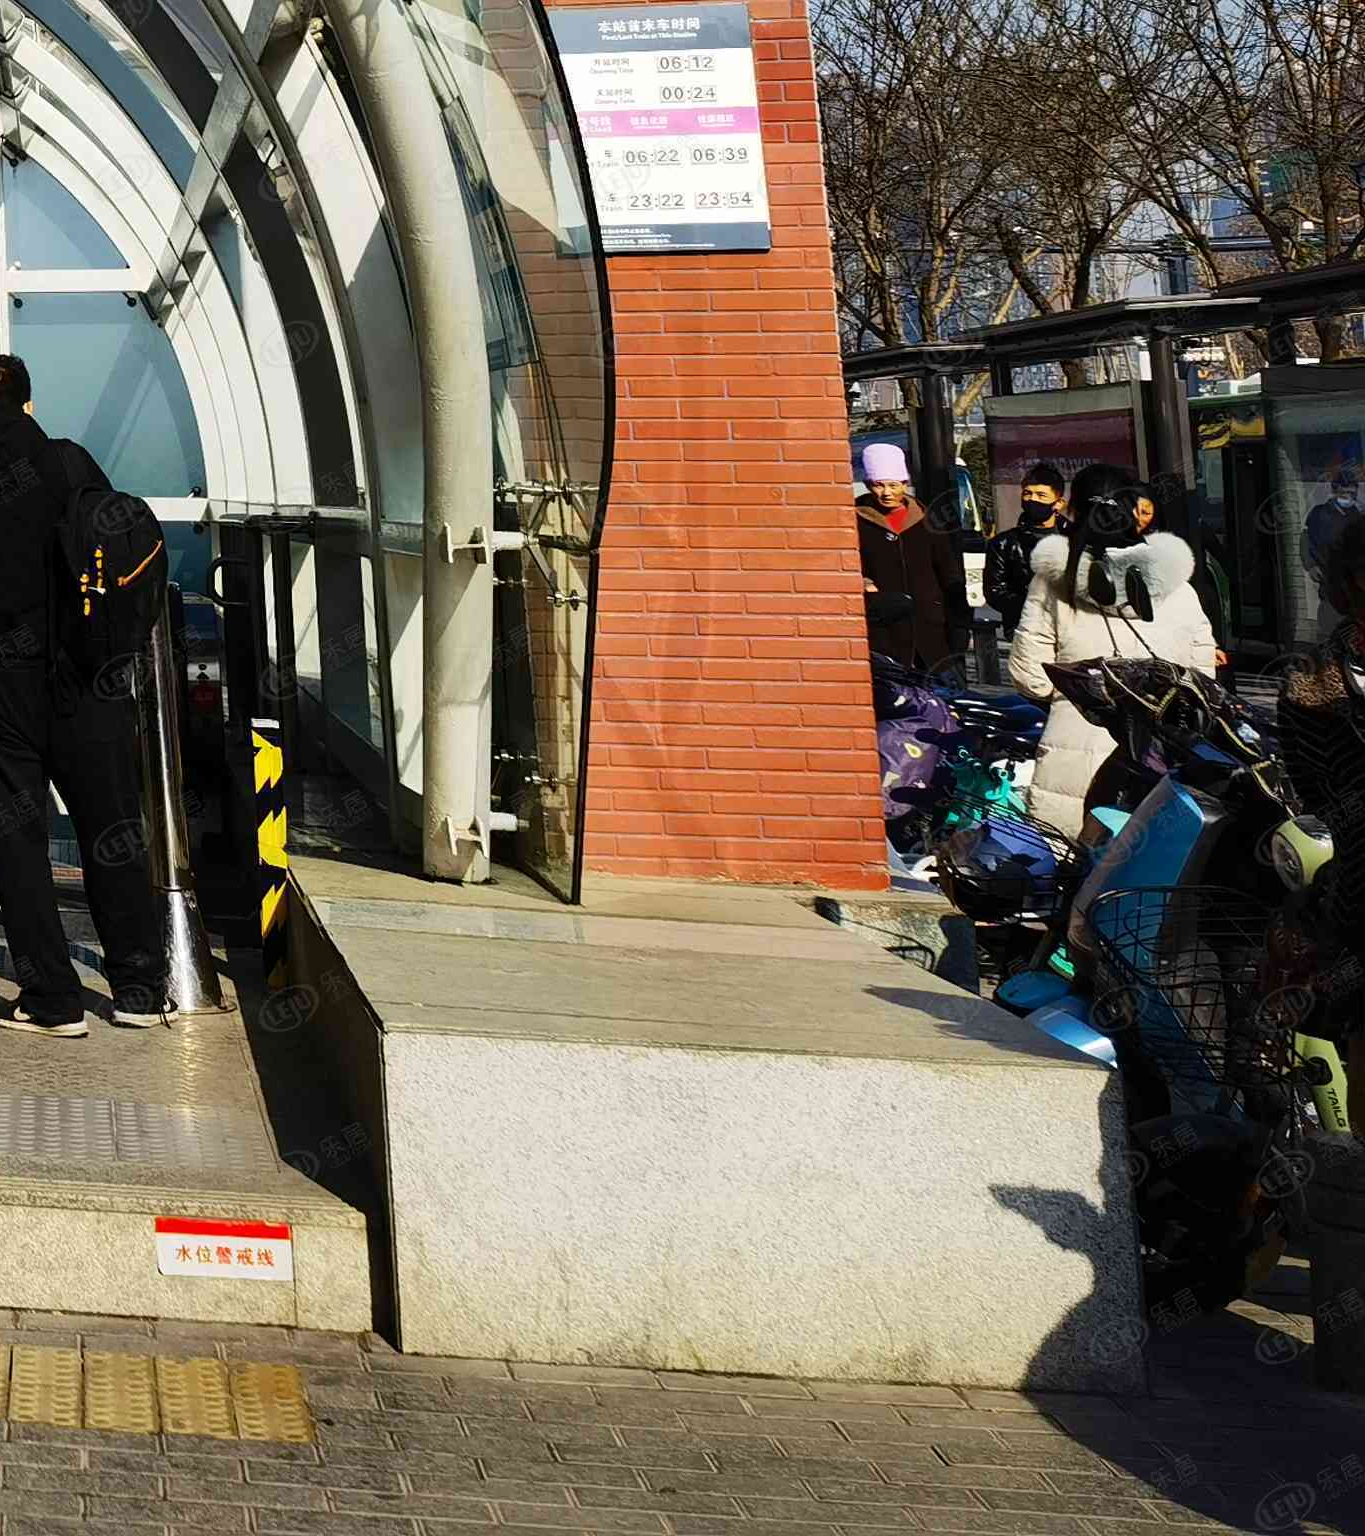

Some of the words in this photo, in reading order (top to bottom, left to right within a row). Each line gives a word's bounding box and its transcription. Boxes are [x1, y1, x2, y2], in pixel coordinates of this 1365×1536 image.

[662, 86, 716, 101] 00:24
[625, 149, 680, 163] 06:22
[692, 146, 749, 162] 06:39
[629, 194, 685, 208] 23:22
[698, 192, 753, 207] 23:54
[175, 1244, 276, 1266] 水位警戒线
